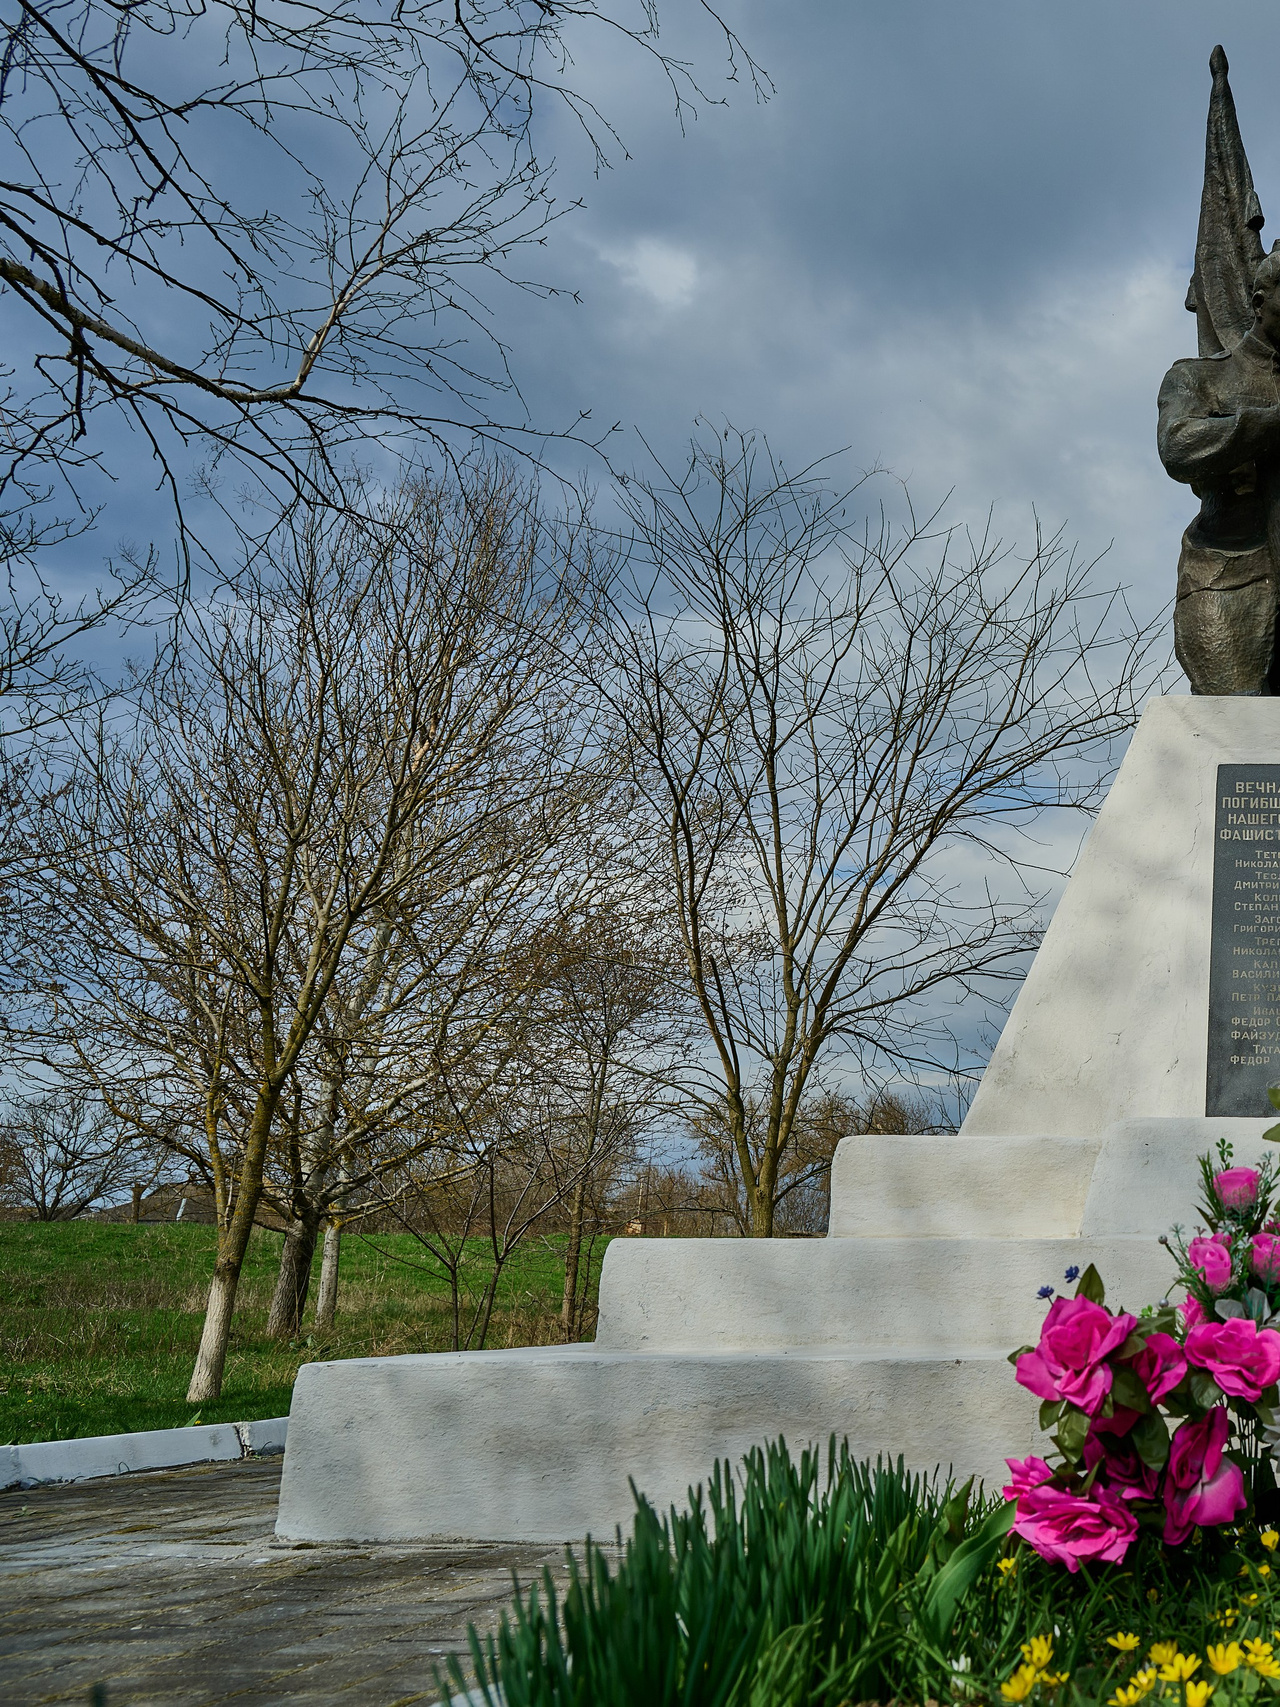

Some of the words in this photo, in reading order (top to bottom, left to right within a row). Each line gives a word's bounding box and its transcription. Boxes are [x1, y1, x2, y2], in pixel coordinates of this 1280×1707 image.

[1234, 902, 1279, 911] СТЕПАН
[1231, 993, 1260, 1001] ПЕТР
[1231, 1016, 1270, 1027] ФЕДОР
[1230, 1055, 1270, 1066] ФЕДОР
